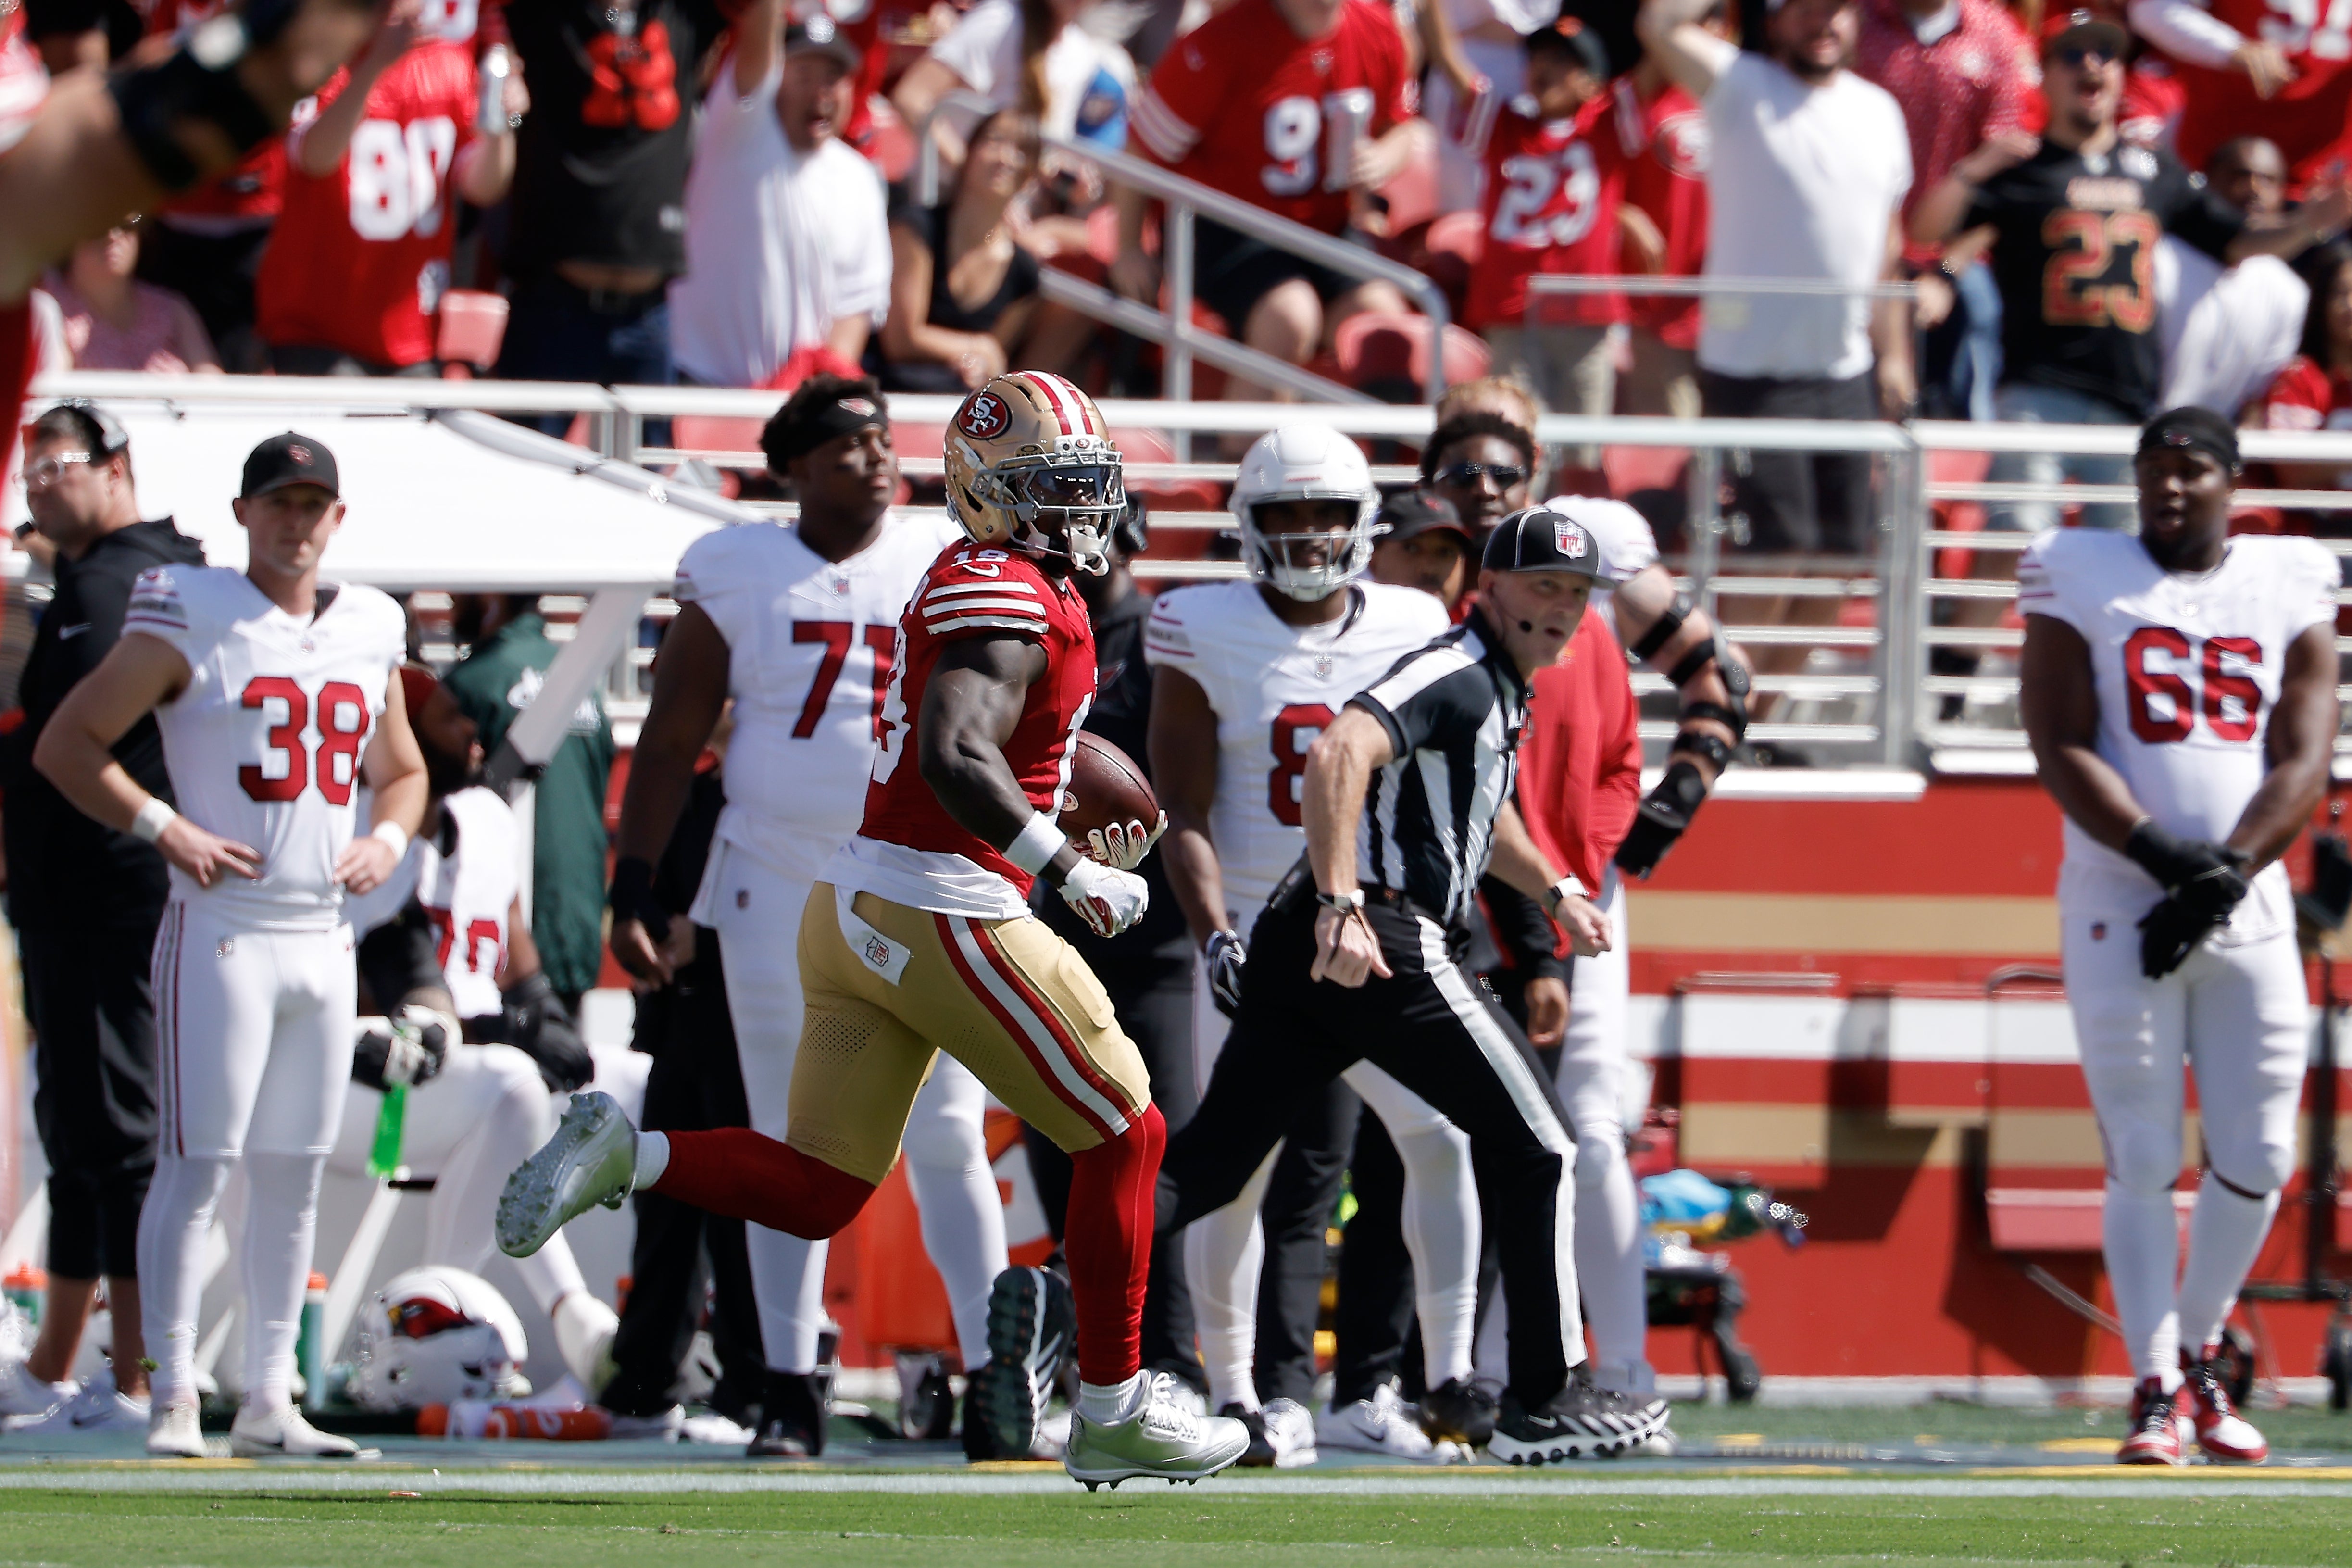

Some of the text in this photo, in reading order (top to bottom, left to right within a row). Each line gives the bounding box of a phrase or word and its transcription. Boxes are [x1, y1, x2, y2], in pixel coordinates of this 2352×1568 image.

[1491, 141, 1601, 248] 23
[2041, 209, 2161, 334] 23
[238, 676, 369, 806] 38
[2125, 627, 2263, 743] 66
[1268, 703, 1335, 827] 8
